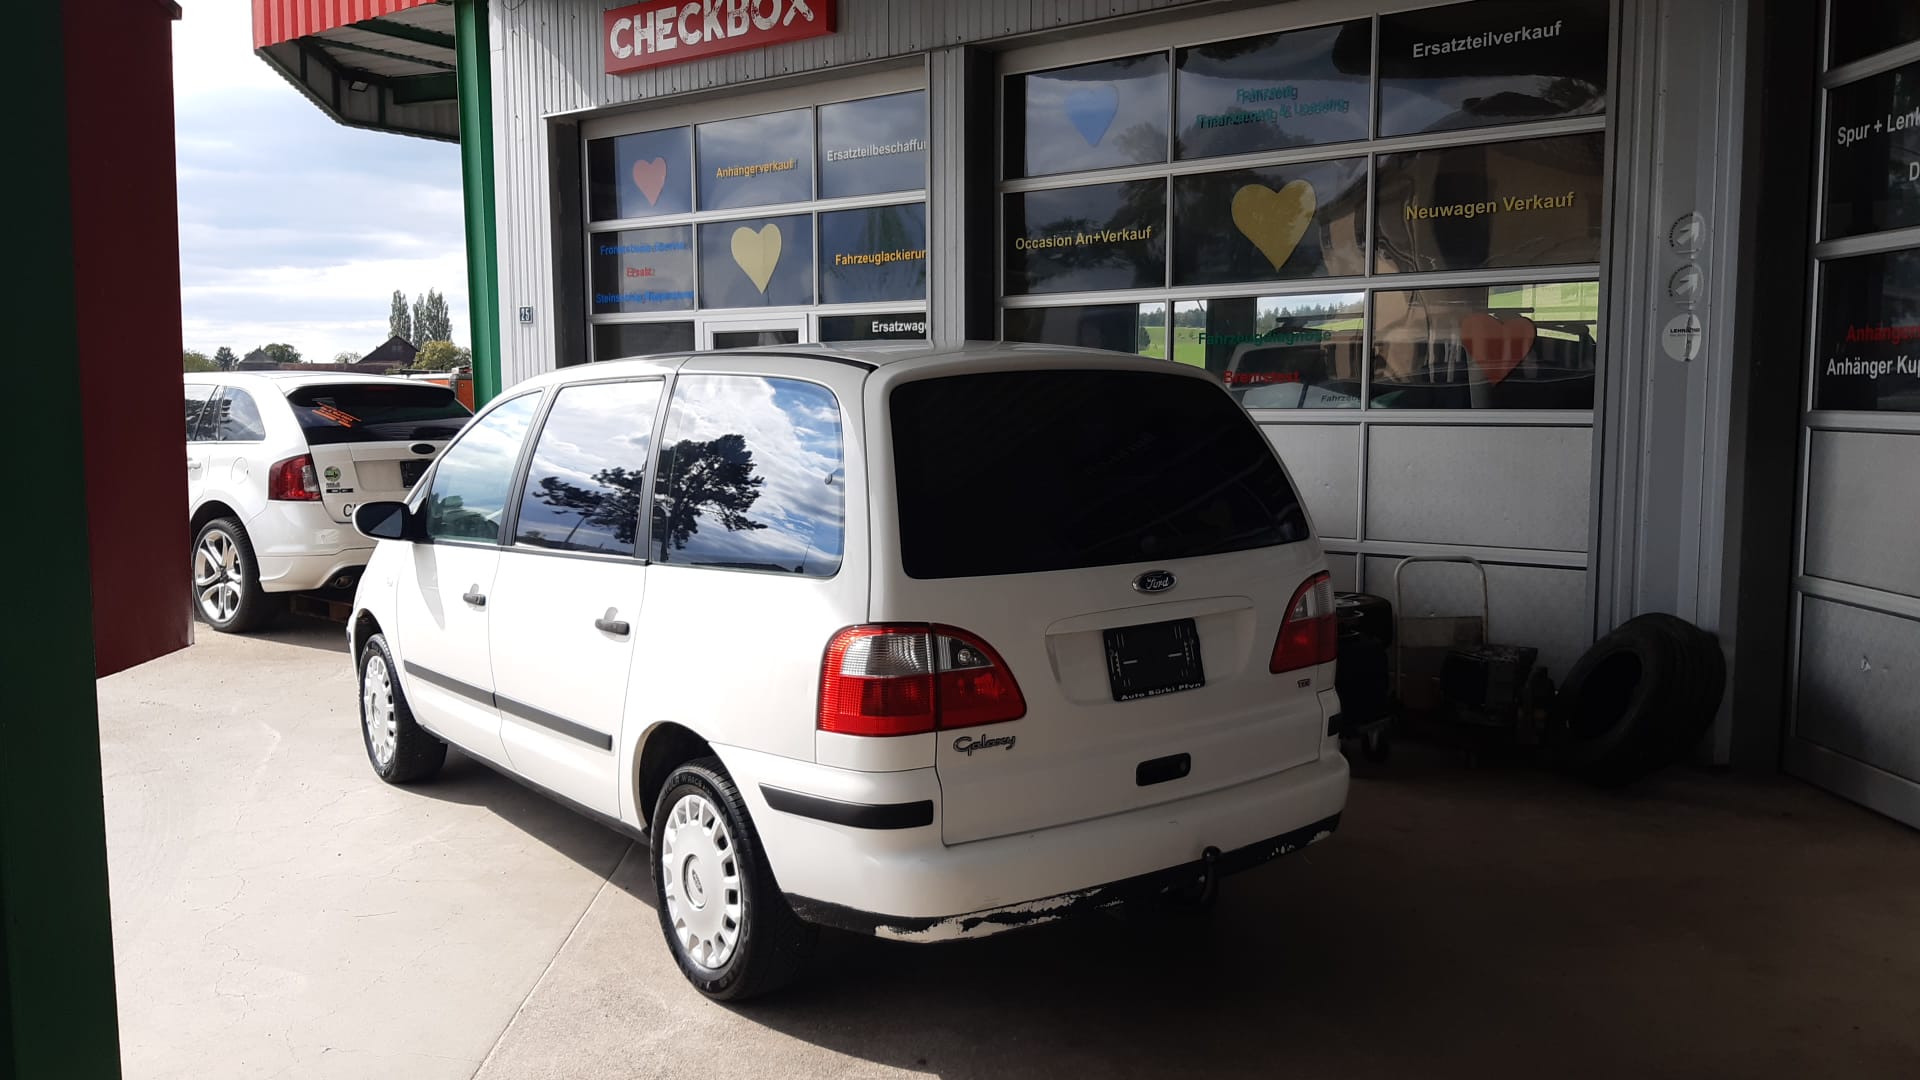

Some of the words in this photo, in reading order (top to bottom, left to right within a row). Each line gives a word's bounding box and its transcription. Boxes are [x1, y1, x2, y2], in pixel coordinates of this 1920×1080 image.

[609, 0, 815, 59] CHECKBOX
[1412, 20, 1563, 58] Ersatzteilverkauf
[1837, 123, 1871, 148] Spur
[1873, 119, 1883, 133] +
[1405, 200, 1497, 220] Neuwagen
[1502, 191, 1576, 212] Verkauf
[1015, 234, 1072, 250] Occasion
[1075, 225, 1152, 246] An+Verkauf
[1826, 356, 1893, 380] Anhänger
[1120, 692, 1145, 701] Auto
[952, 733, 1017, 757] Galaxy
